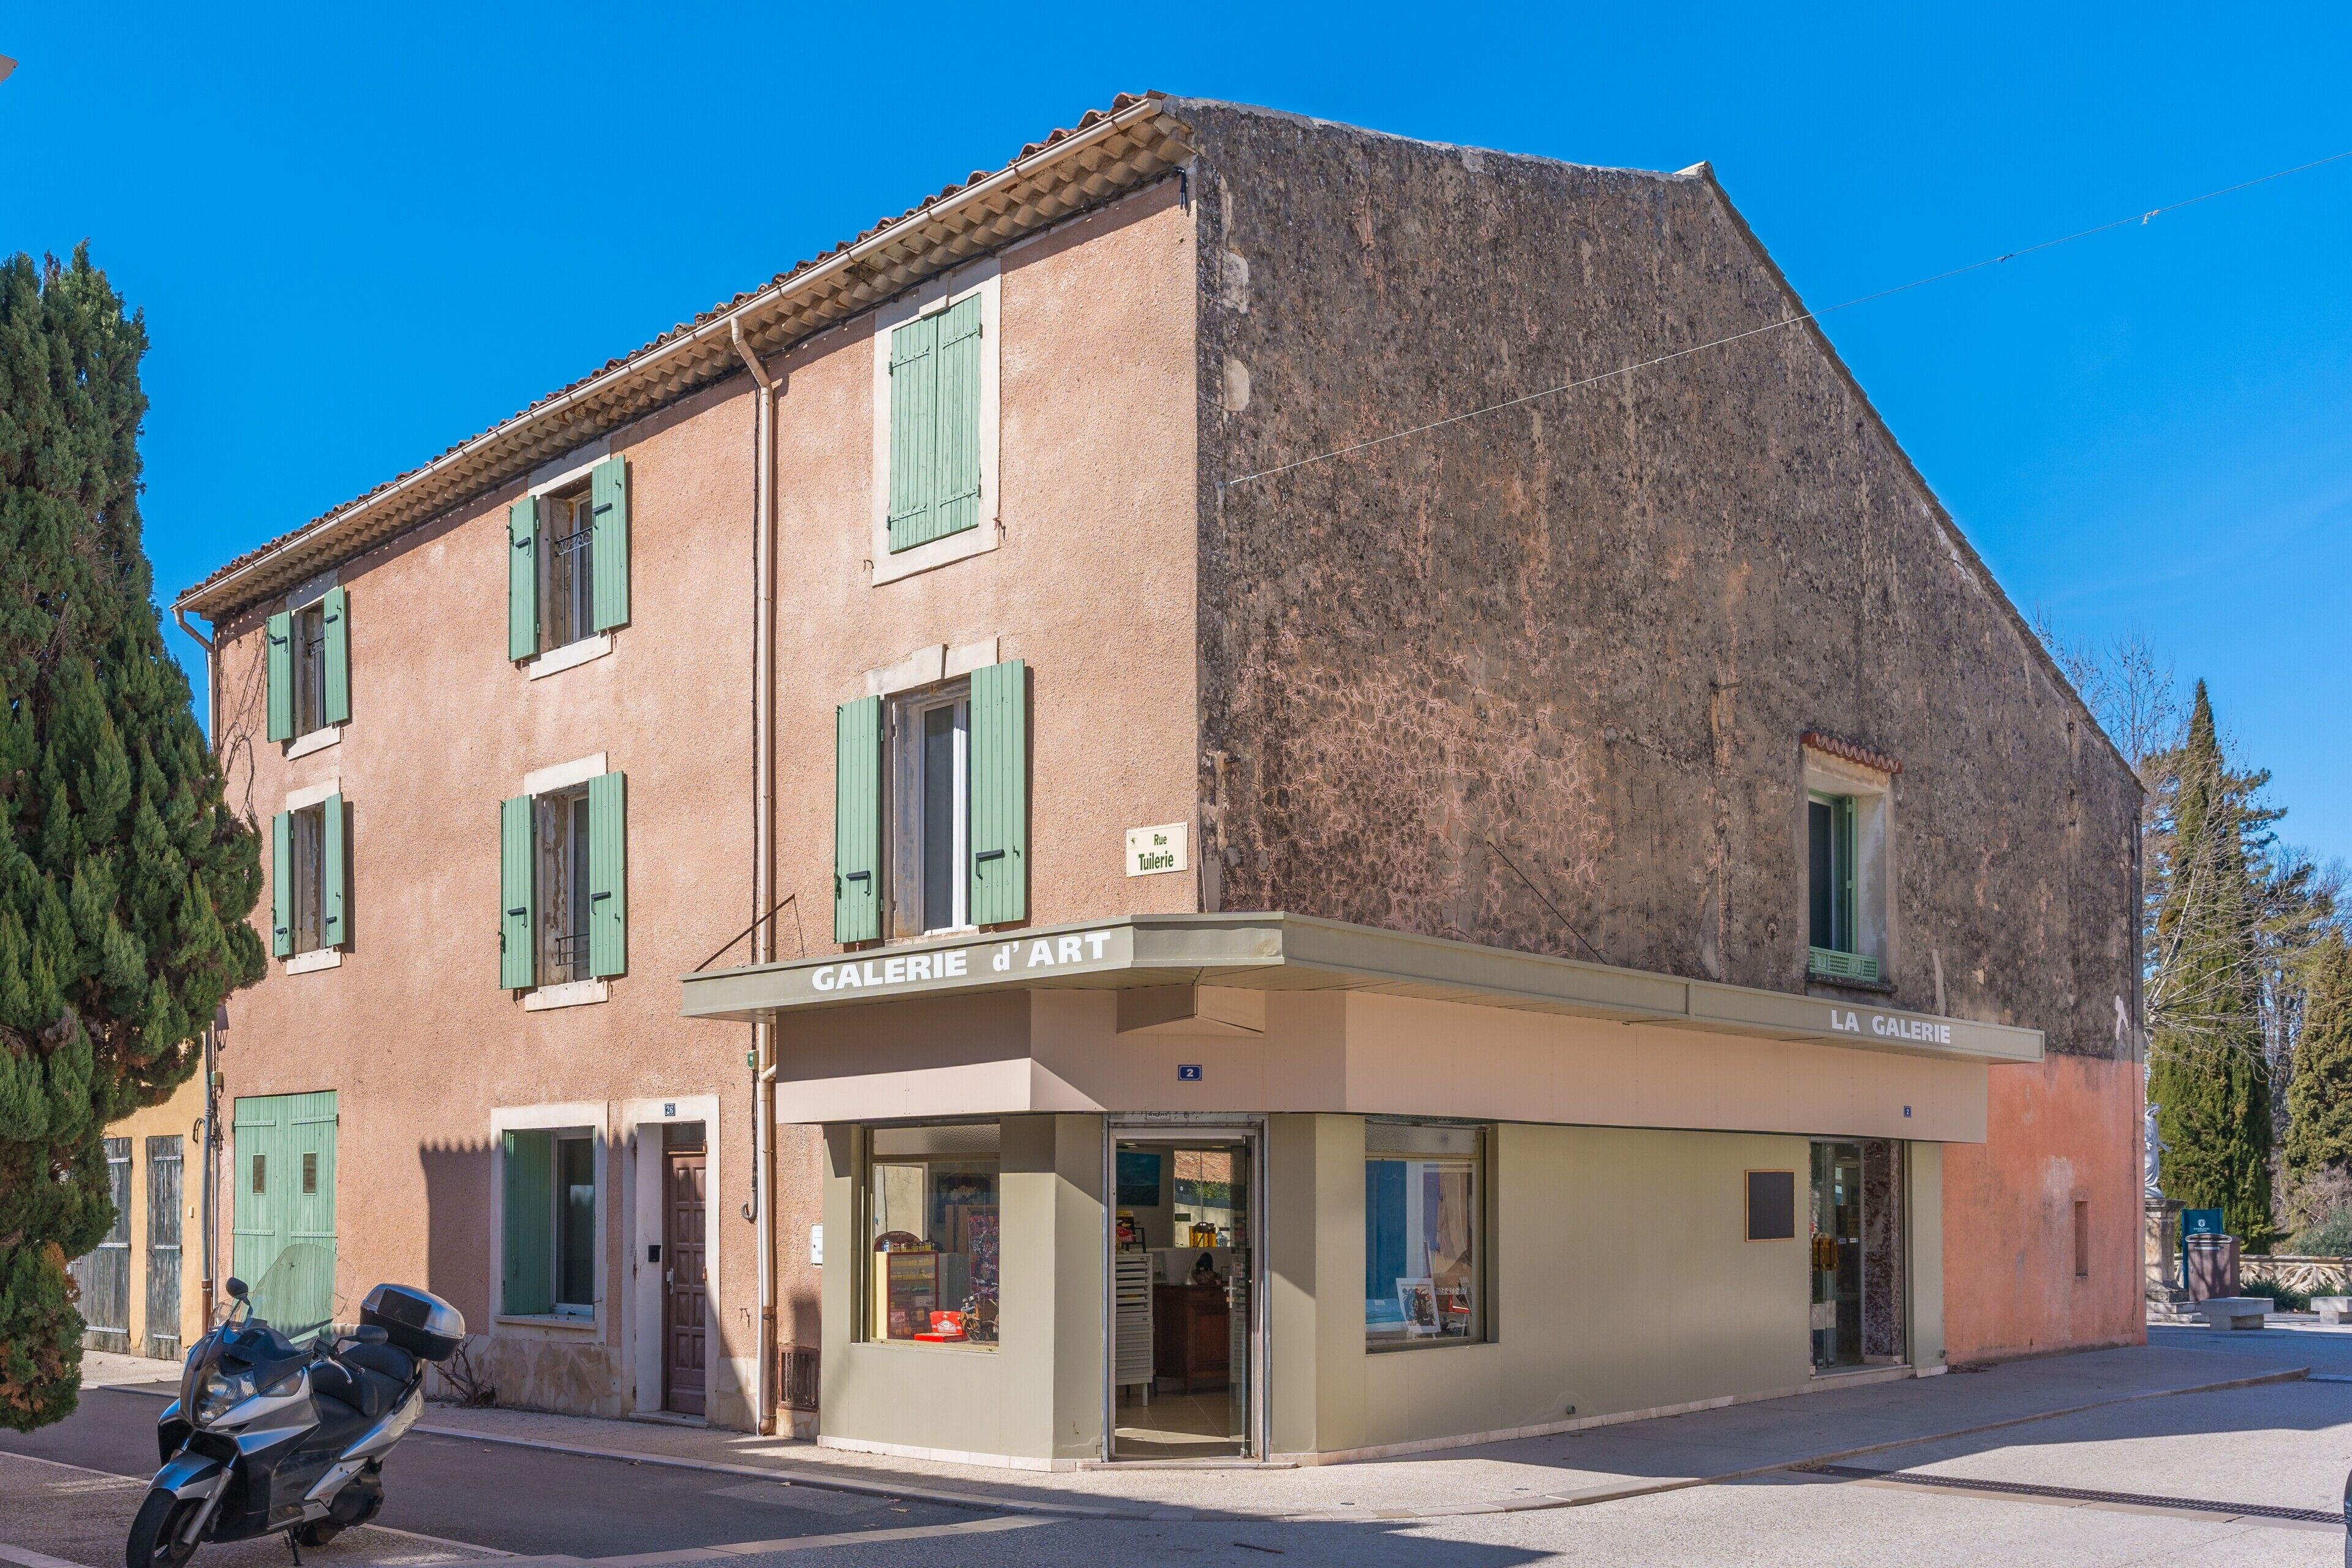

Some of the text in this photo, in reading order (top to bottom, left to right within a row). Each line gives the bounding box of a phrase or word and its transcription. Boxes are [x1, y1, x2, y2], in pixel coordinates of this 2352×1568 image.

[1154, 834, 1167, 846] Rue
[1138, 850, 1174, 871] Tuilerie
[812, 930, 1112, 992] GALERIE d'ART
[1831, 1009, 1951, 1044] LA GALERIE
[1186, 1068, 1194, 1077] 2
[666, 1105, 674, 1114] 26
